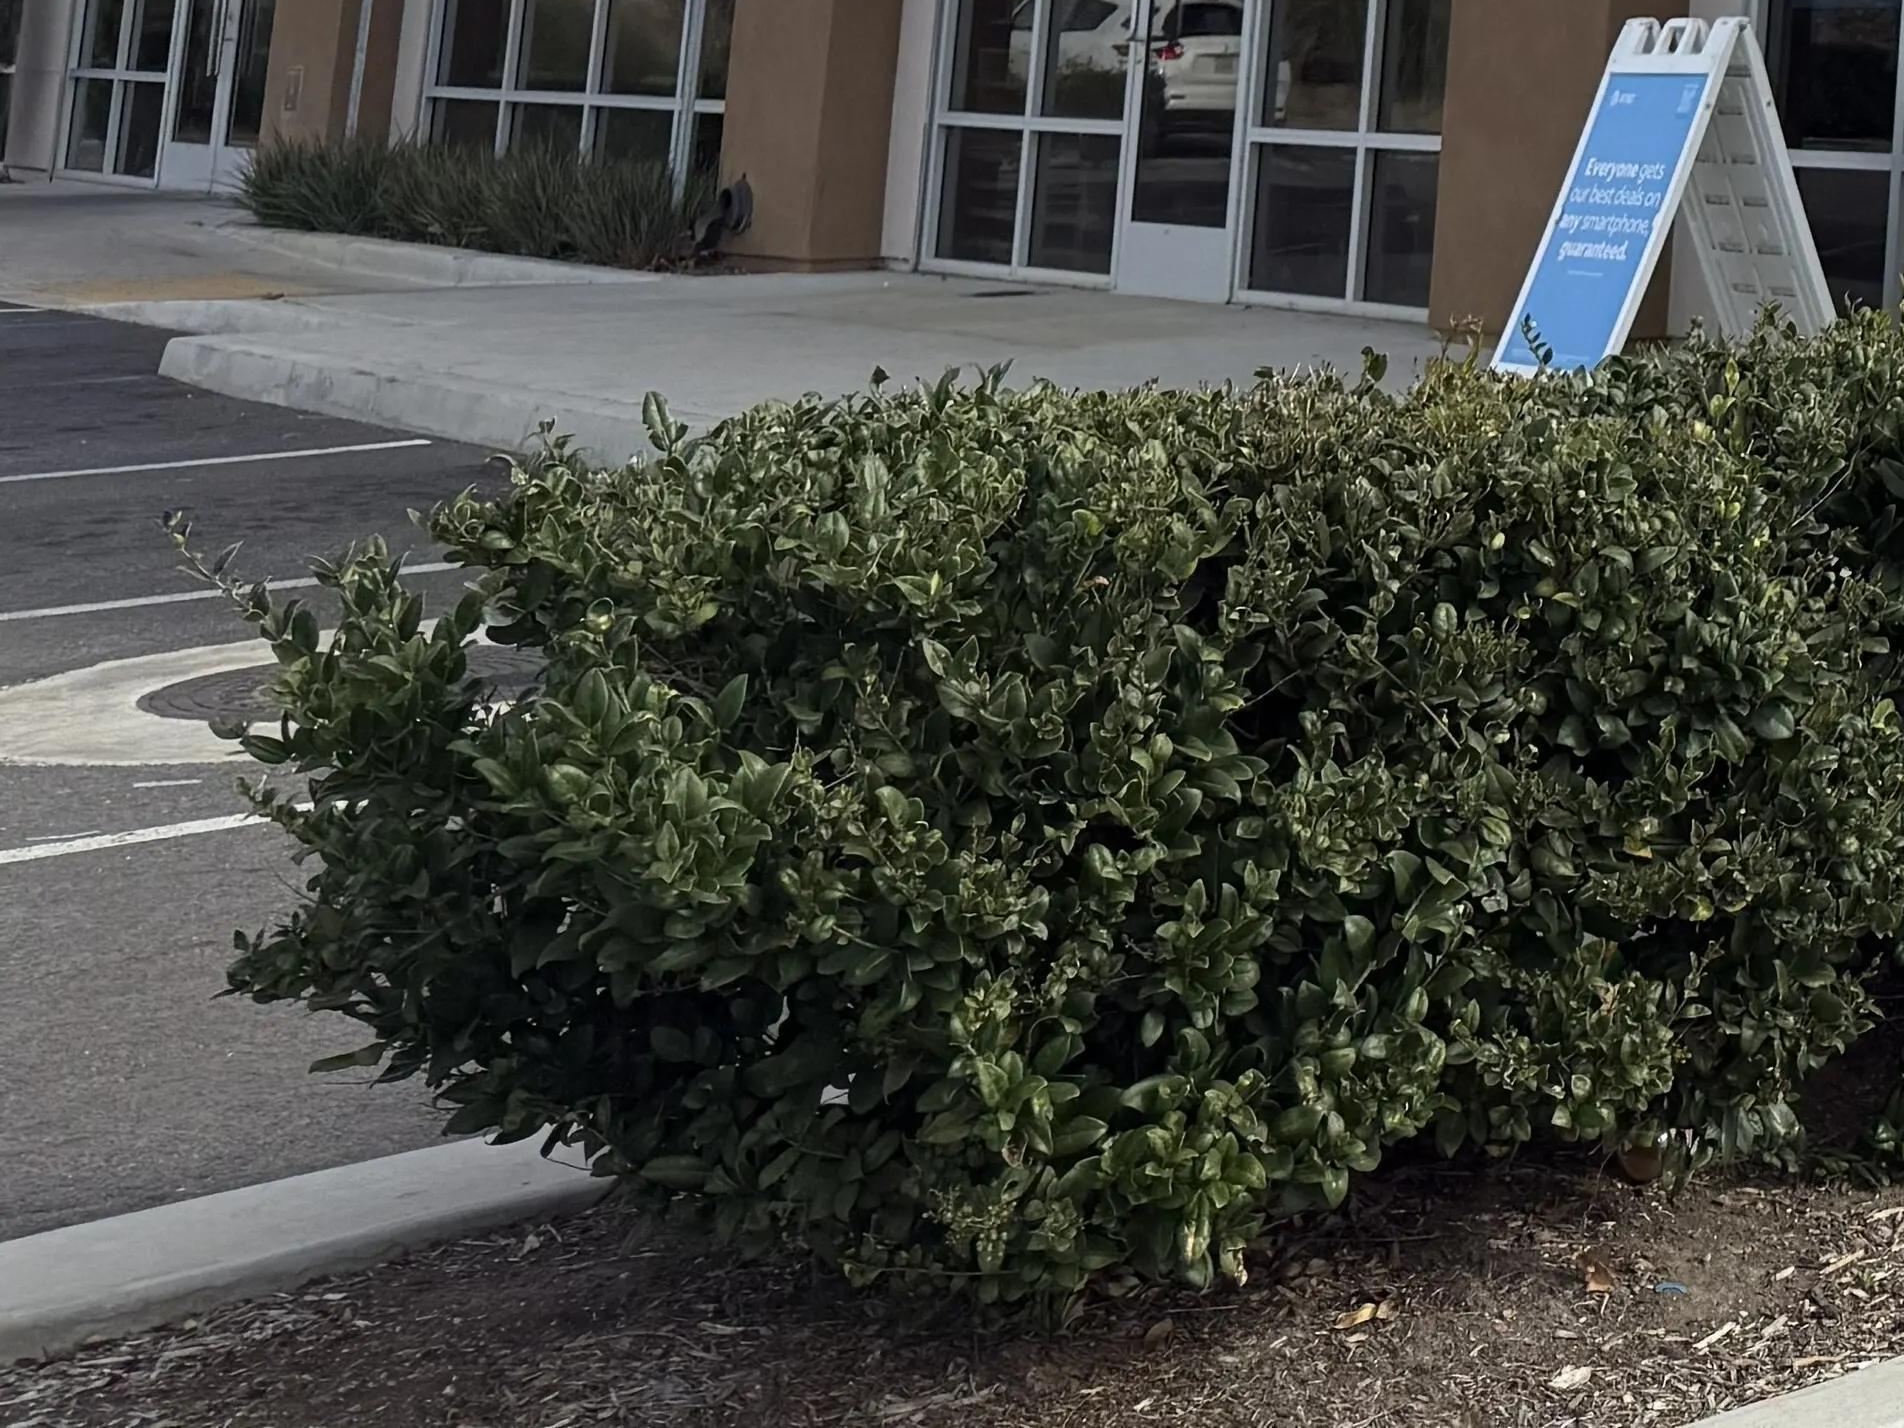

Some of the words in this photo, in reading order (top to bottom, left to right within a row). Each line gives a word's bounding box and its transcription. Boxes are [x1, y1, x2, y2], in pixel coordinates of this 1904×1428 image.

[1584, 157, 1639, 183] Everyone
[1637, 162, 1666, 185] gets
[1588, 184, 1616, 205] best
[1614, 185, 1645, 206] deals
[1644, 190, 1662, 208] on
[1558, 213, 1582, 235] any
